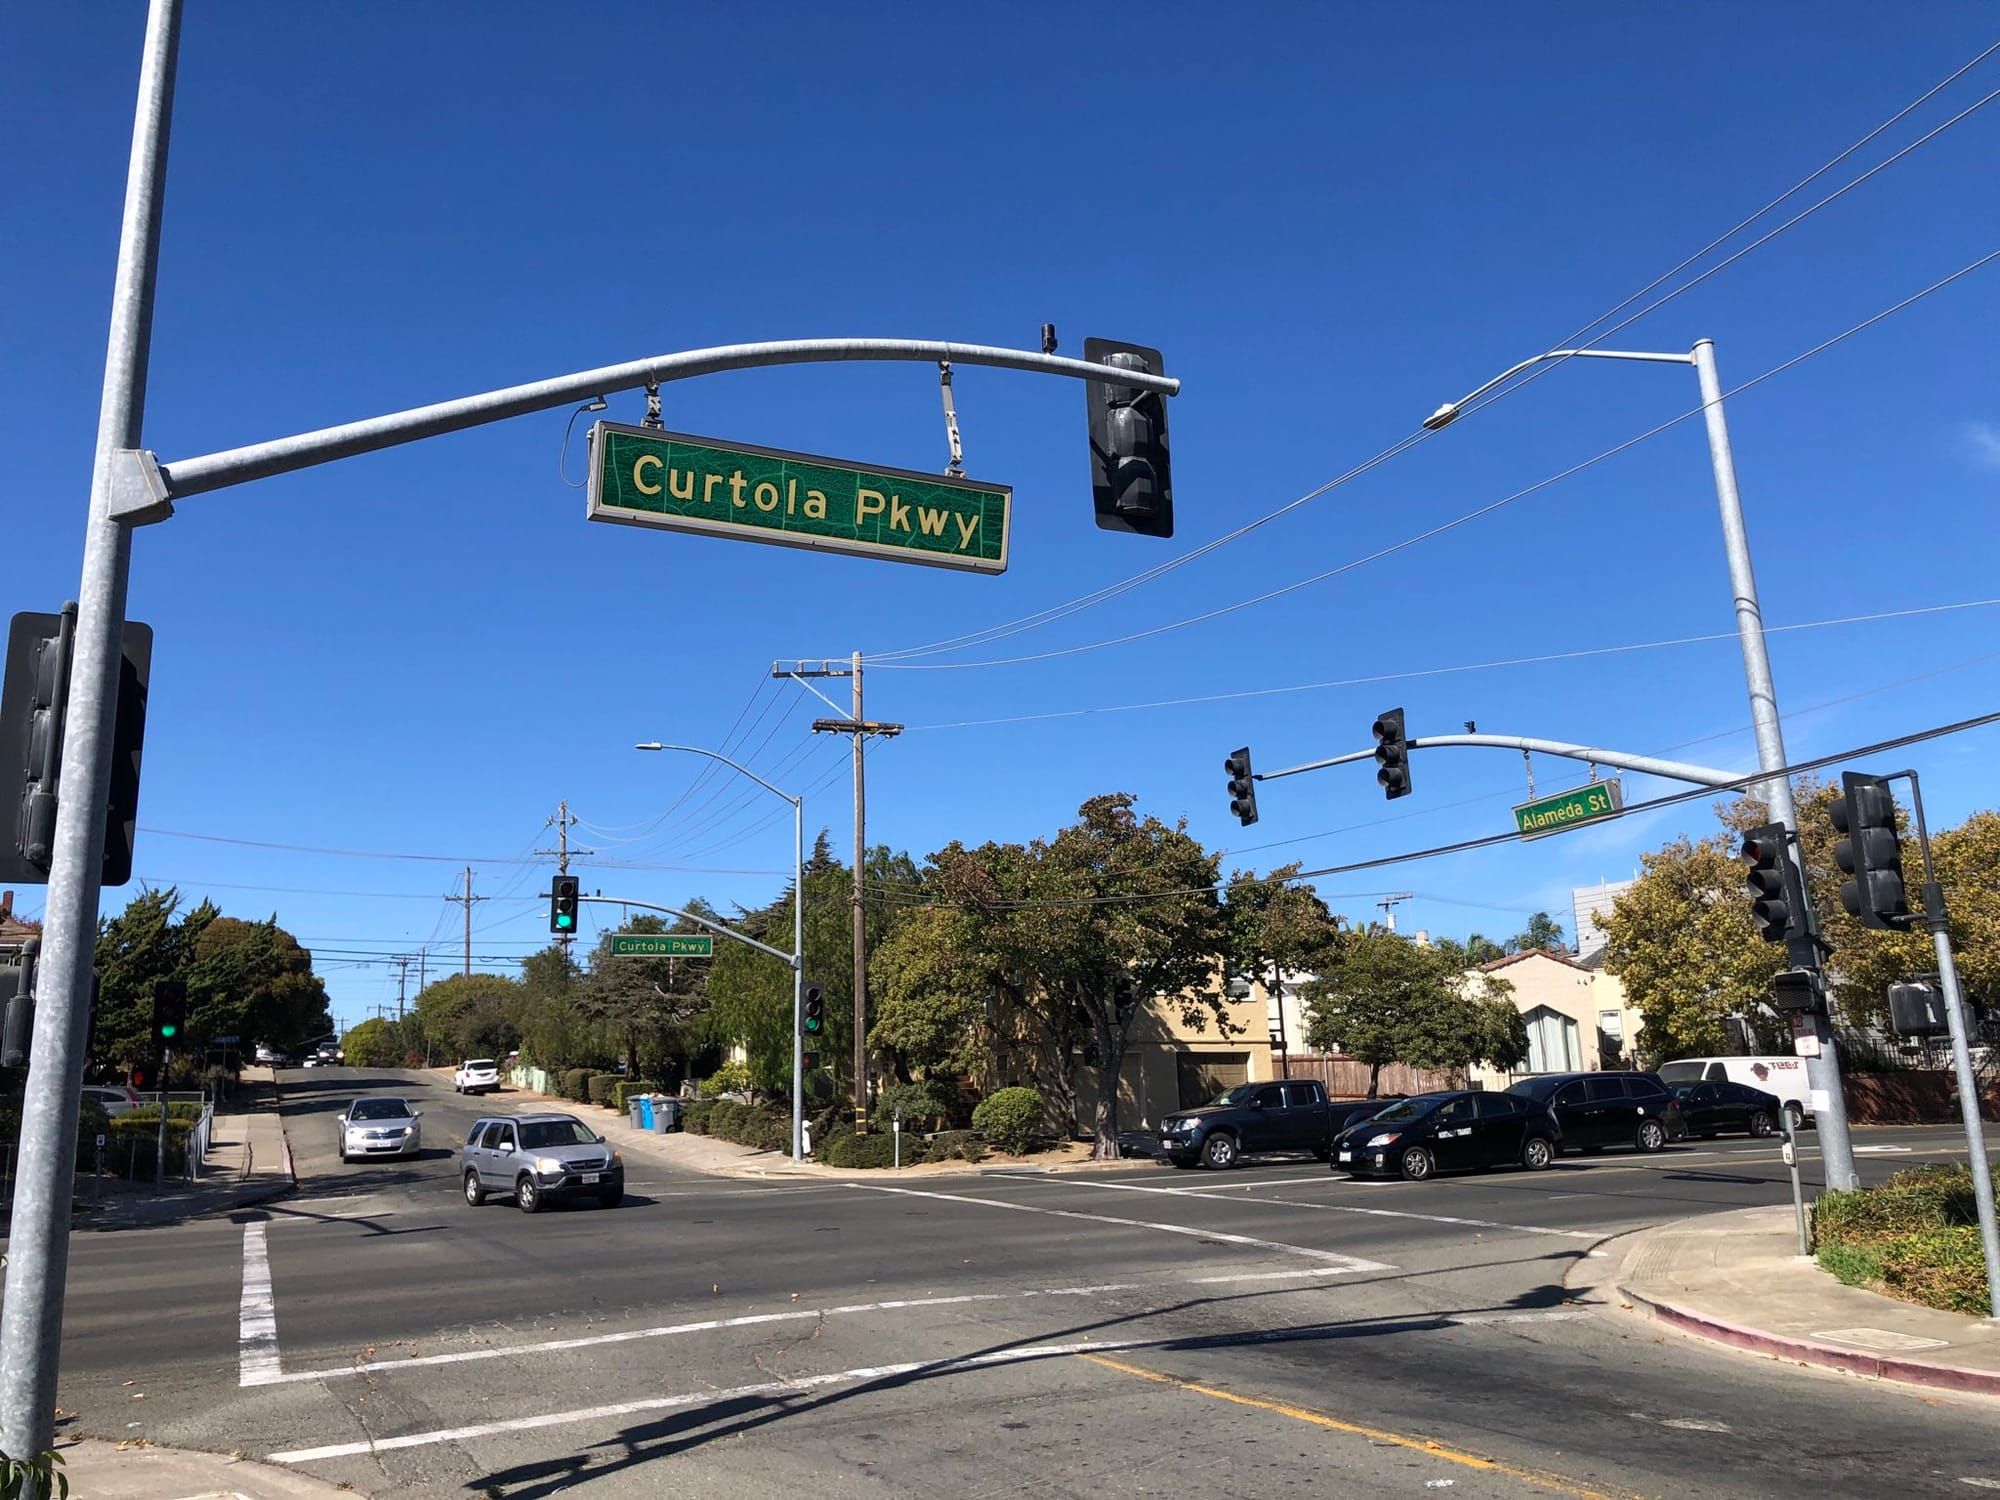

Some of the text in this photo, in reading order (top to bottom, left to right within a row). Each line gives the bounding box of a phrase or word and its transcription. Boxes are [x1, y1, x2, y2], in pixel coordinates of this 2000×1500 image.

[633, 455, 979, 549] Curtola Pkwy
[1523, 793, 1608, 831] Alameda St
[619, 941, 705, 952] Curtola Pkwy
